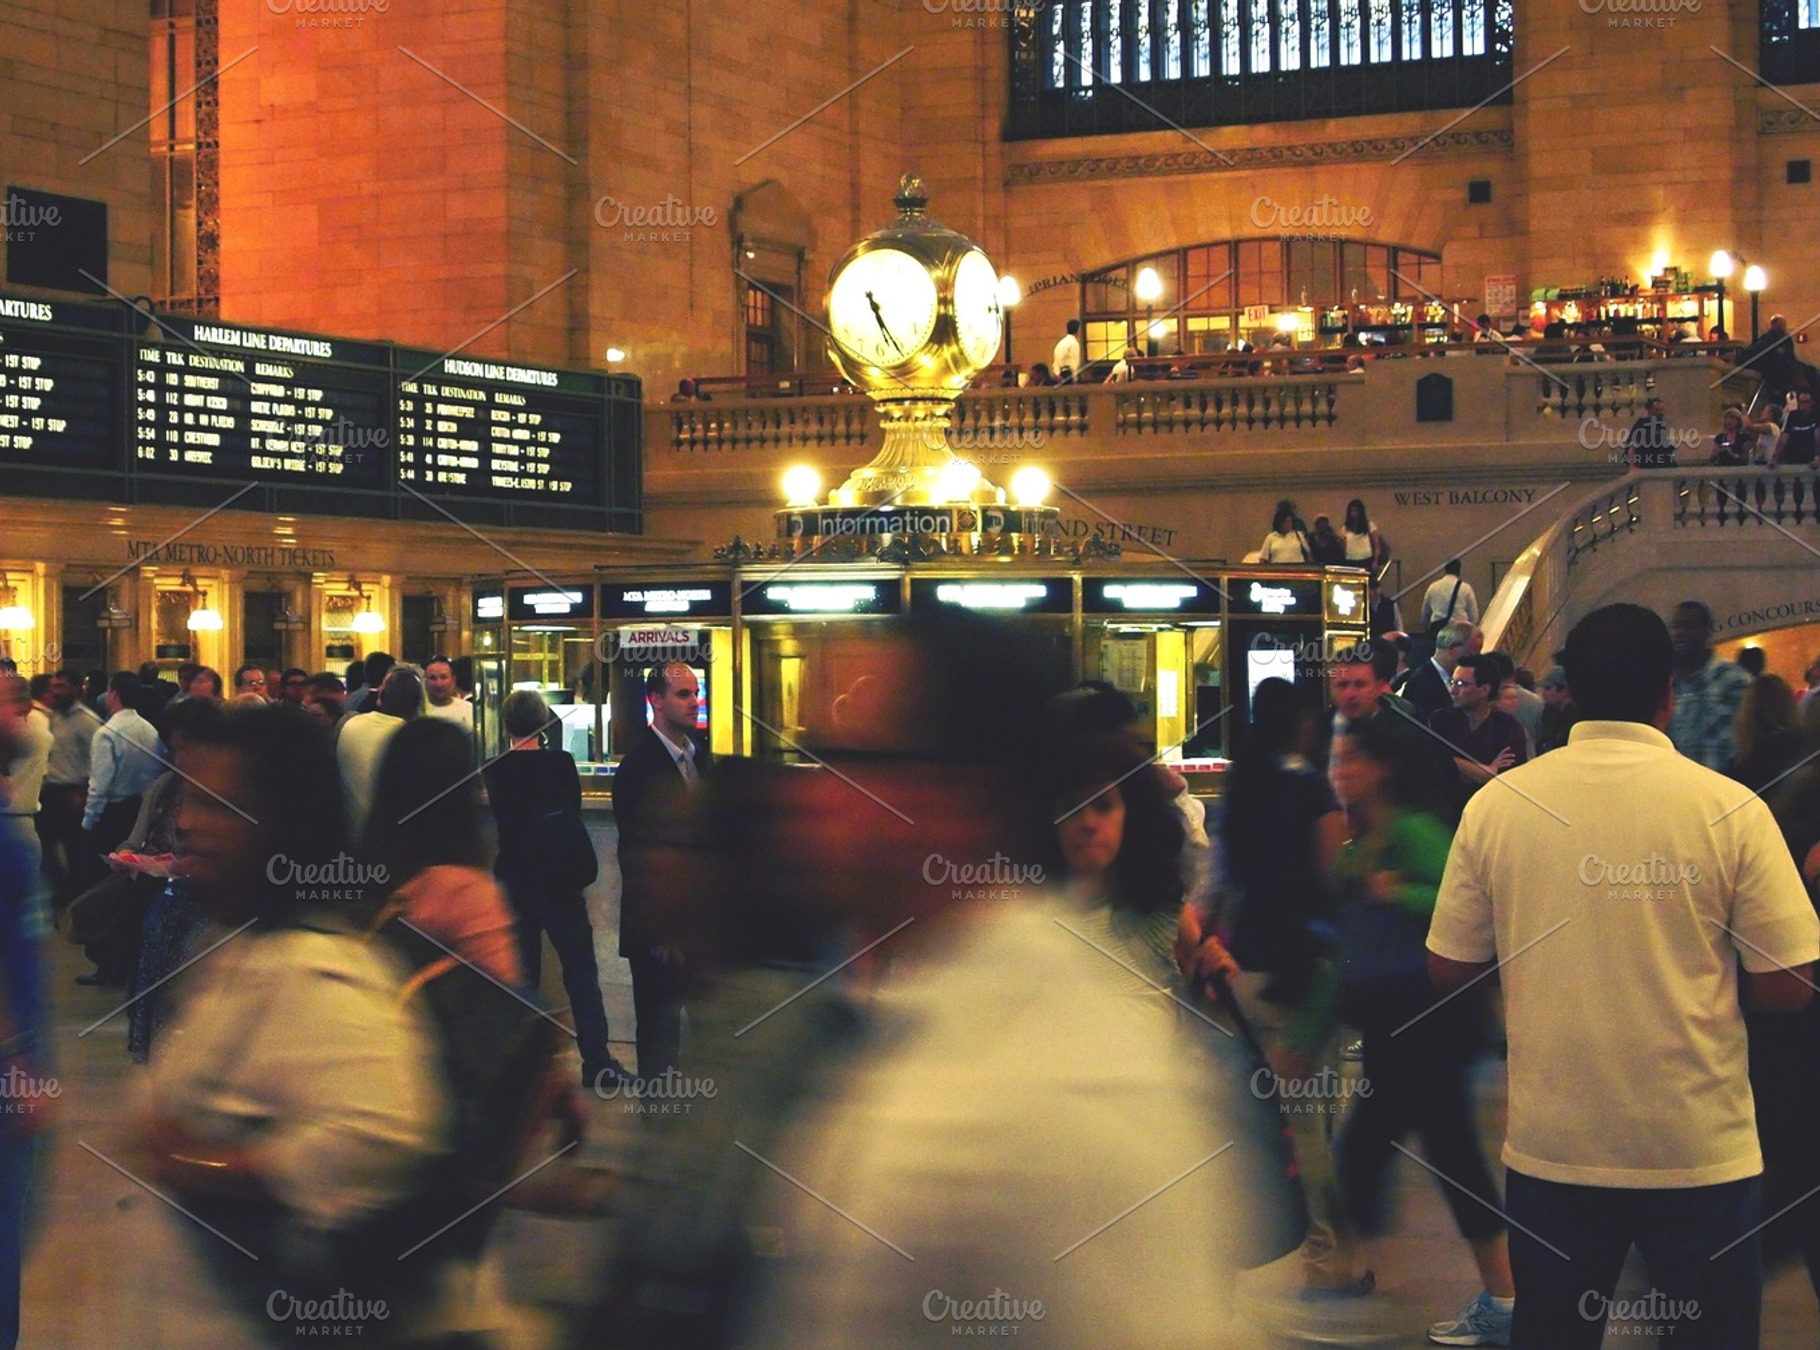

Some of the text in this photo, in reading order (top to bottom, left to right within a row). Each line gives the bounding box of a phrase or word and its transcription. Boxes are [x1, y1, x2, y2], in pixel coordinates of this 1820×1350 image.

[194, 324, 332, 358] HARLEM LINE DEPARTURES
[444, 359, 558, 387] HUDSON LINE DEPARTURES
[1394, 488, 1537, 506] WEST BALCONY
[1094, 522, 1178, 547] STREET
[629, 630, 690, 644] ARRIVALS
